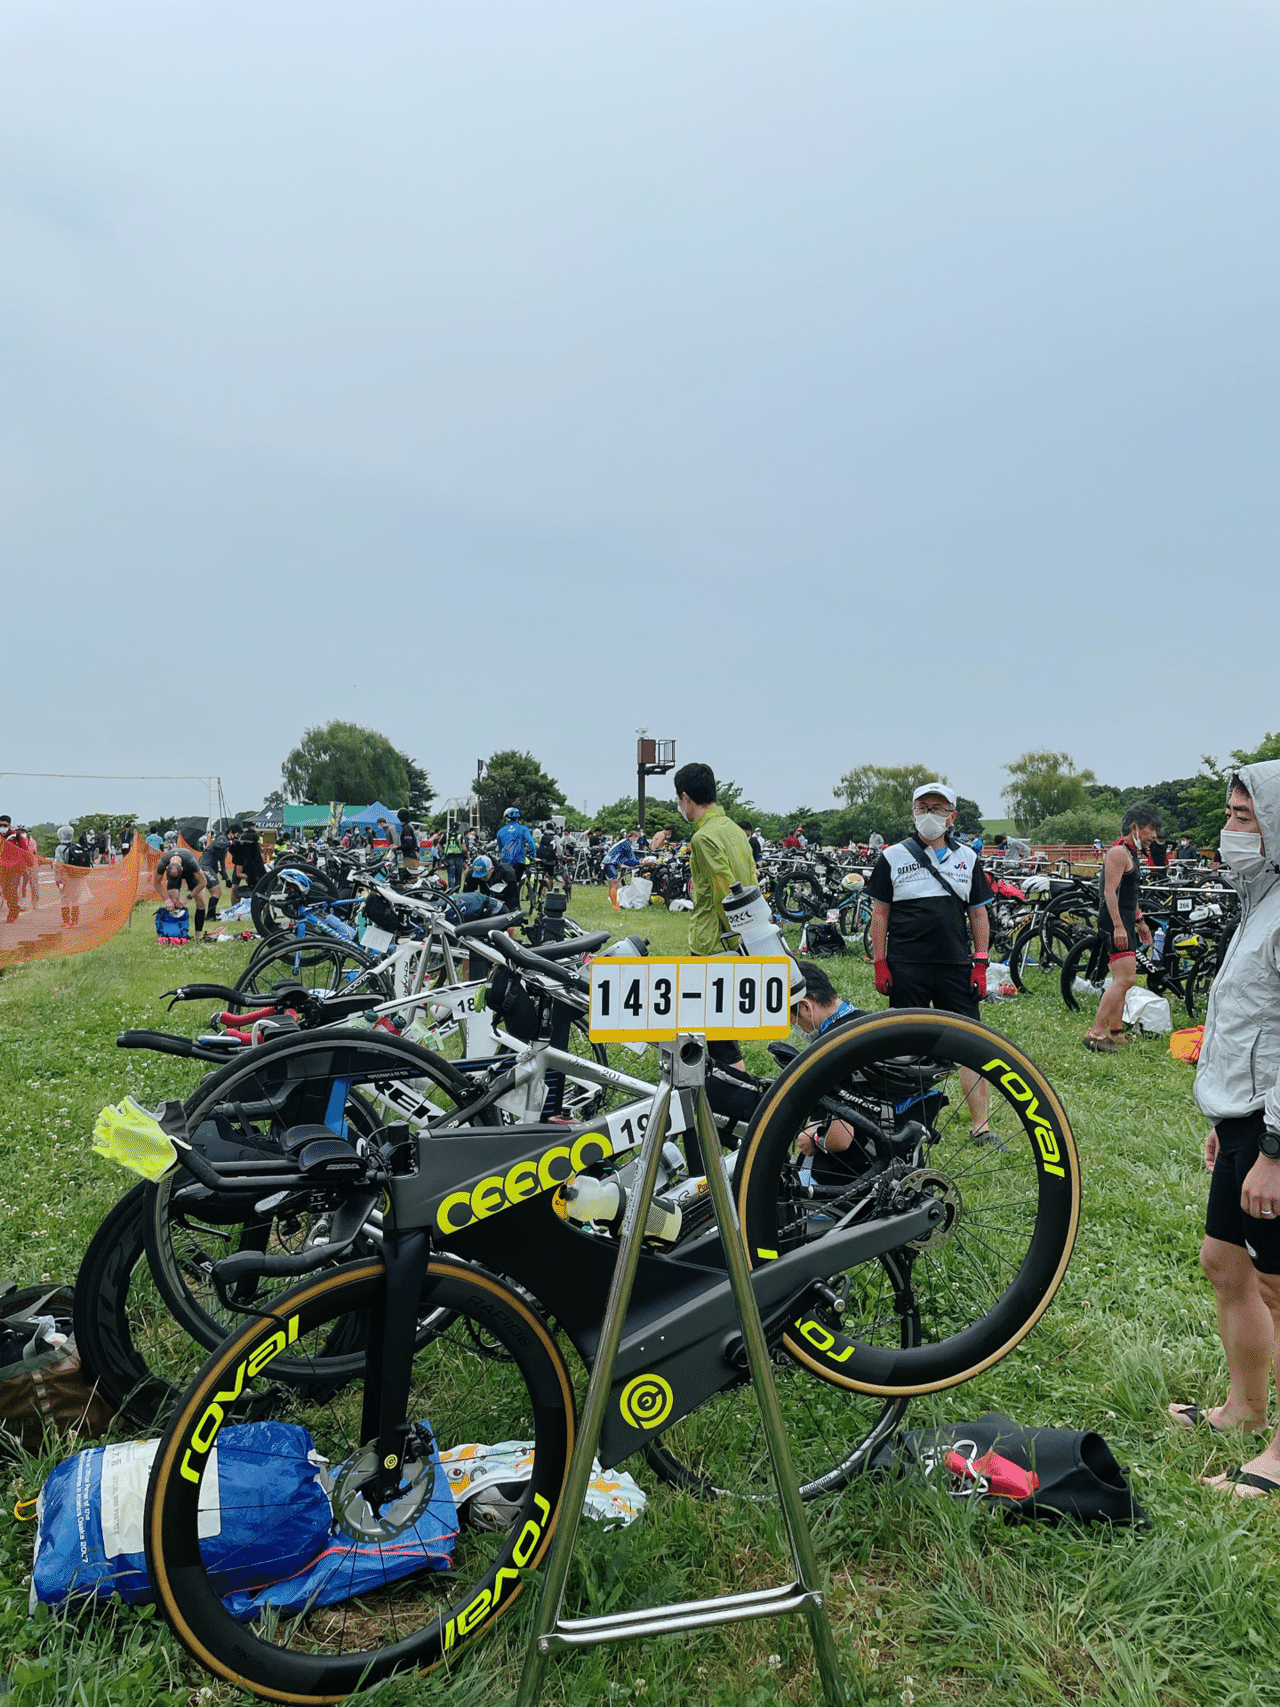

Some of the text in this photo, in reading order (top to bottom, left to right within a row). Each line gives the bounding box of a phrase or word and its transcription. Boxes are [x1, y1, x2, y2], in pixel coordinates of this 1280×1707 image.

[457, 997, 486, 1014] 18
[601, 1069, 621, 1082] 201
[462, 1295, 534, 1348] RAPIDE
[77, 1517, 86, 1540] Osaka
